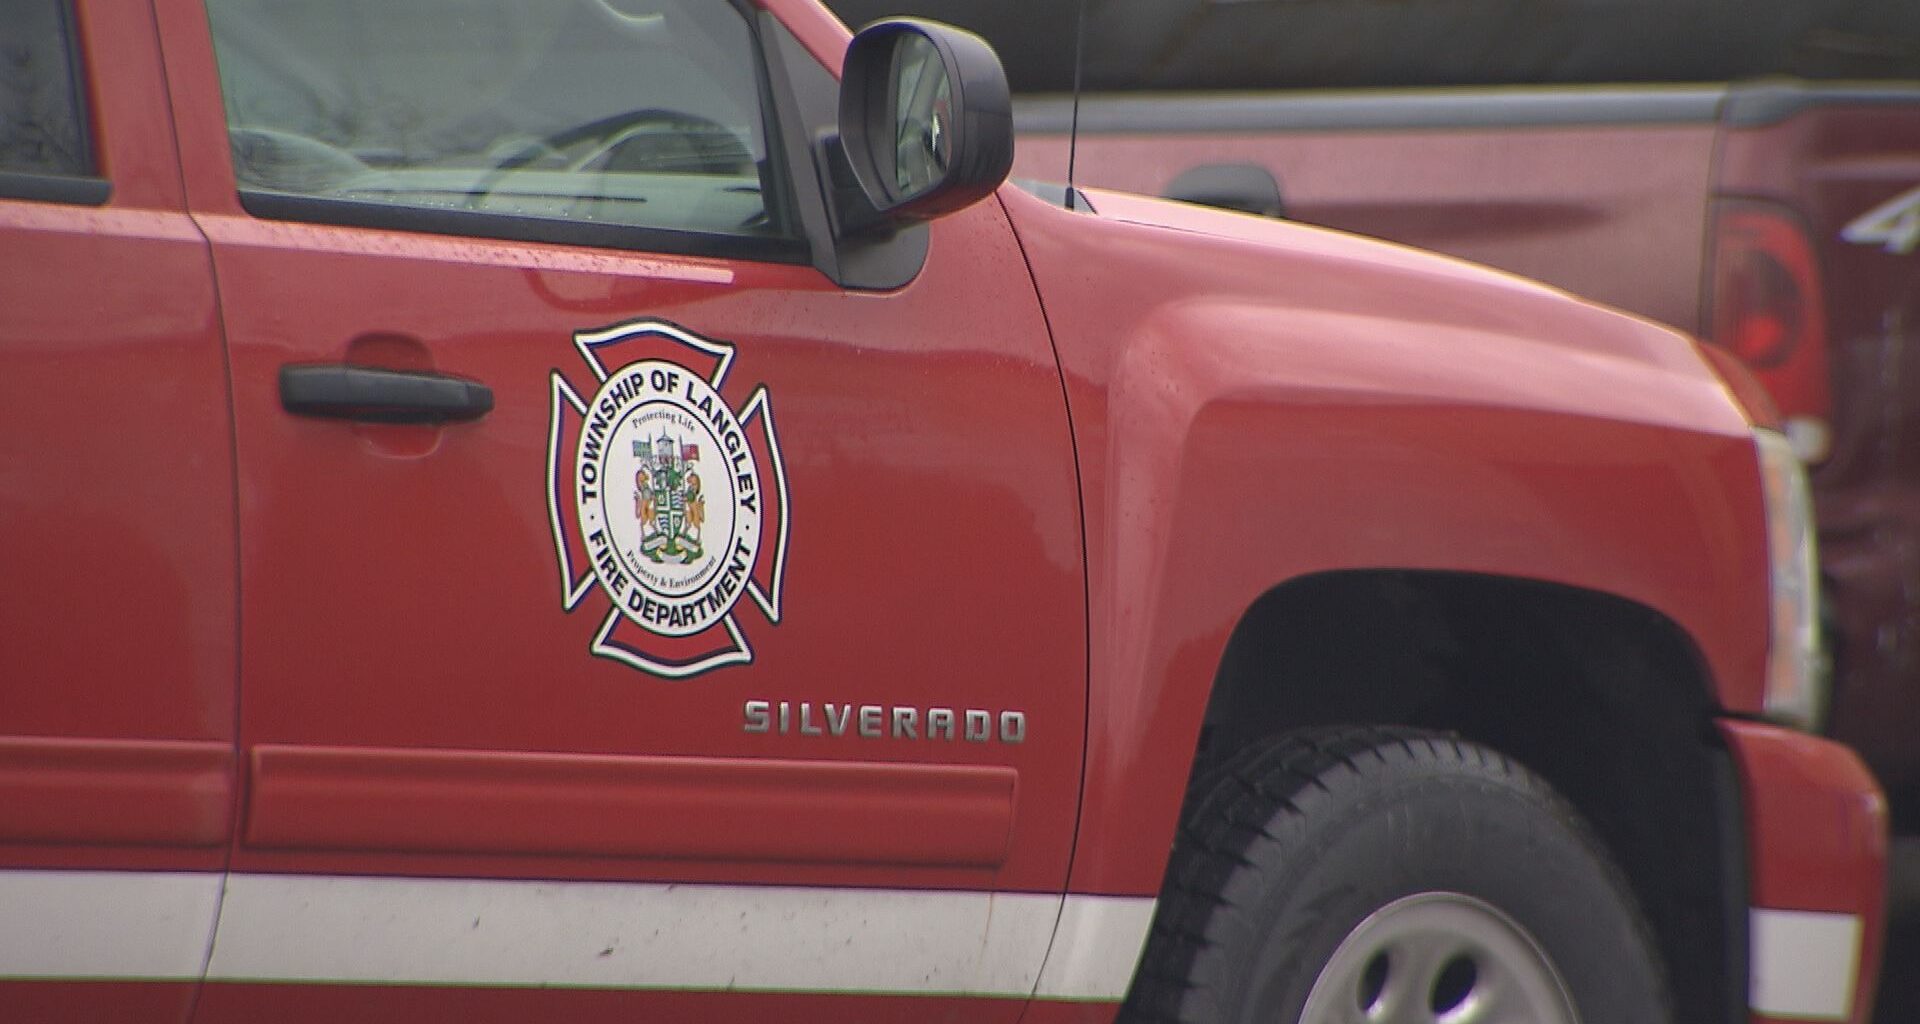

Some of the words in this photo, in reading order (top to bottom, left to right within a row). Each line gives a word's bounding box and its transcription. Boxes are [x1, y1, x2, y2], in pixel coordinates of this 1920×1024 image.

[581, 371, 645, 504] TOWNSHIP
[651, 370, 679, 392] OF
[686, 380, 757, 514] LANGLEY
[632, 410, 675, 429] Protecting
[678, 414, 695, 431] Life
[589, 528, 629, 597] FIRE
[627, 536, 752, 628] DEPARTMENT
[626, 550, 658, 586] Property
[660, 579, 667, 588] &
[669, 556, 717, 588] Environment
[744, 700, 1026, 744] SILVERADO
